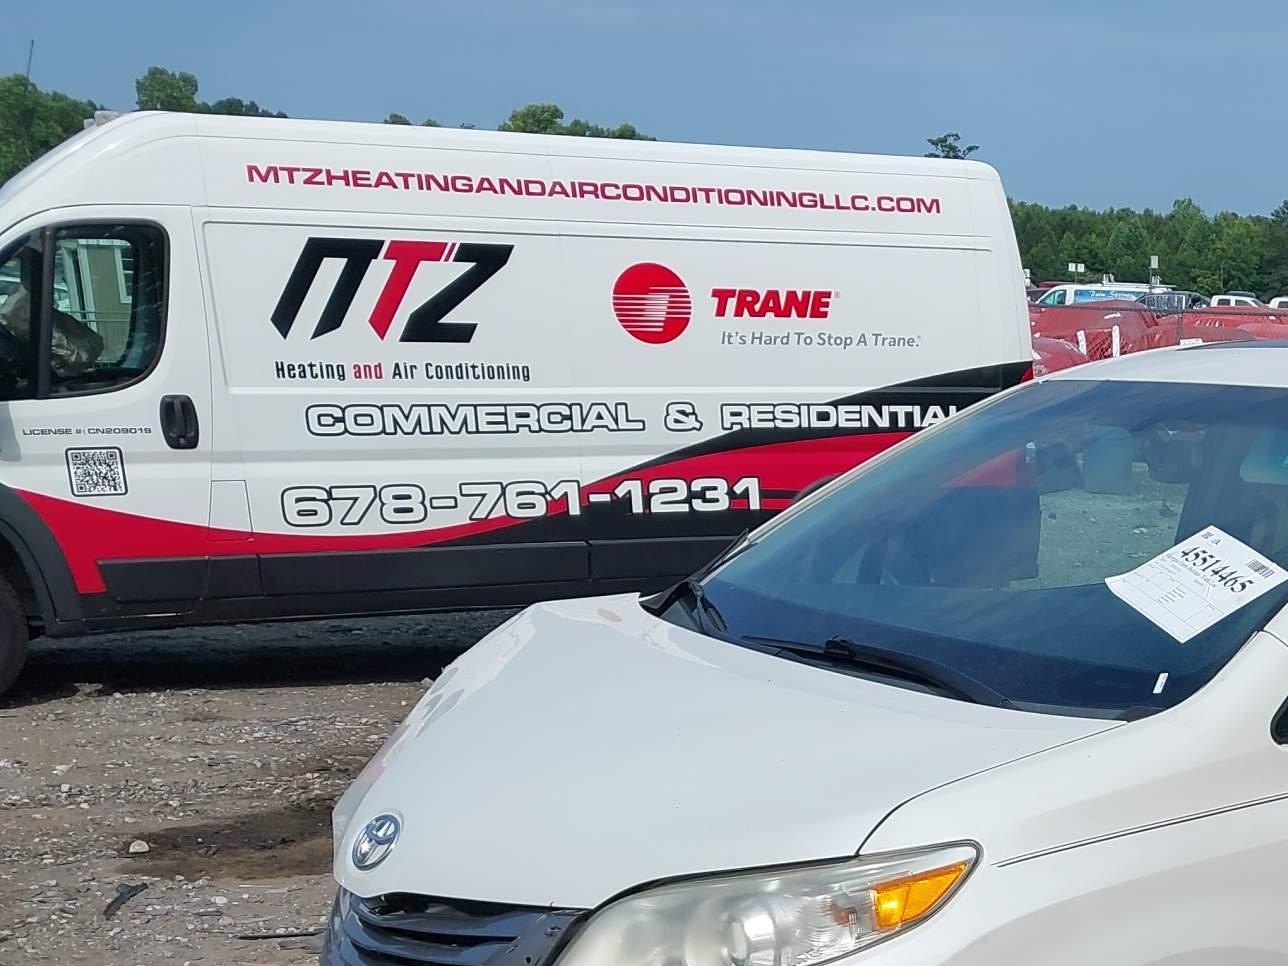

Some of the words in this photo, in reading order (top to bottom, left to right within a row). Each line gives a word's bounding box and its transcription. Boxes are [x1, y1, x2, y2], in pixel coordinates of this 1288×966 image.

[246, 164, 942, 215] MTZHEATINGANDAIRCONDITIONINGLLC.COM
[270, 236, 516, 344] MTZ
[751, 331, 790, 346] Hard
[794, 332, 813, 347] To
[817, 332, 853, 350] Stop
[856, 333, 868, 347] A
[275, 361, 346, 382] Heating
[352, 361, 384, 381] and
[391, 362, 418, 382] Air
[424, 362, 531, 382] Conditioning
[22, 428, 73, 436] LICENSE
[306, 402, 645, 437] COMMERCIAL
[664, 402, 703, 432] &
[281, 477, 763, 527] 678-761-1231
[1180, 546, 1256, 594] 45514465
